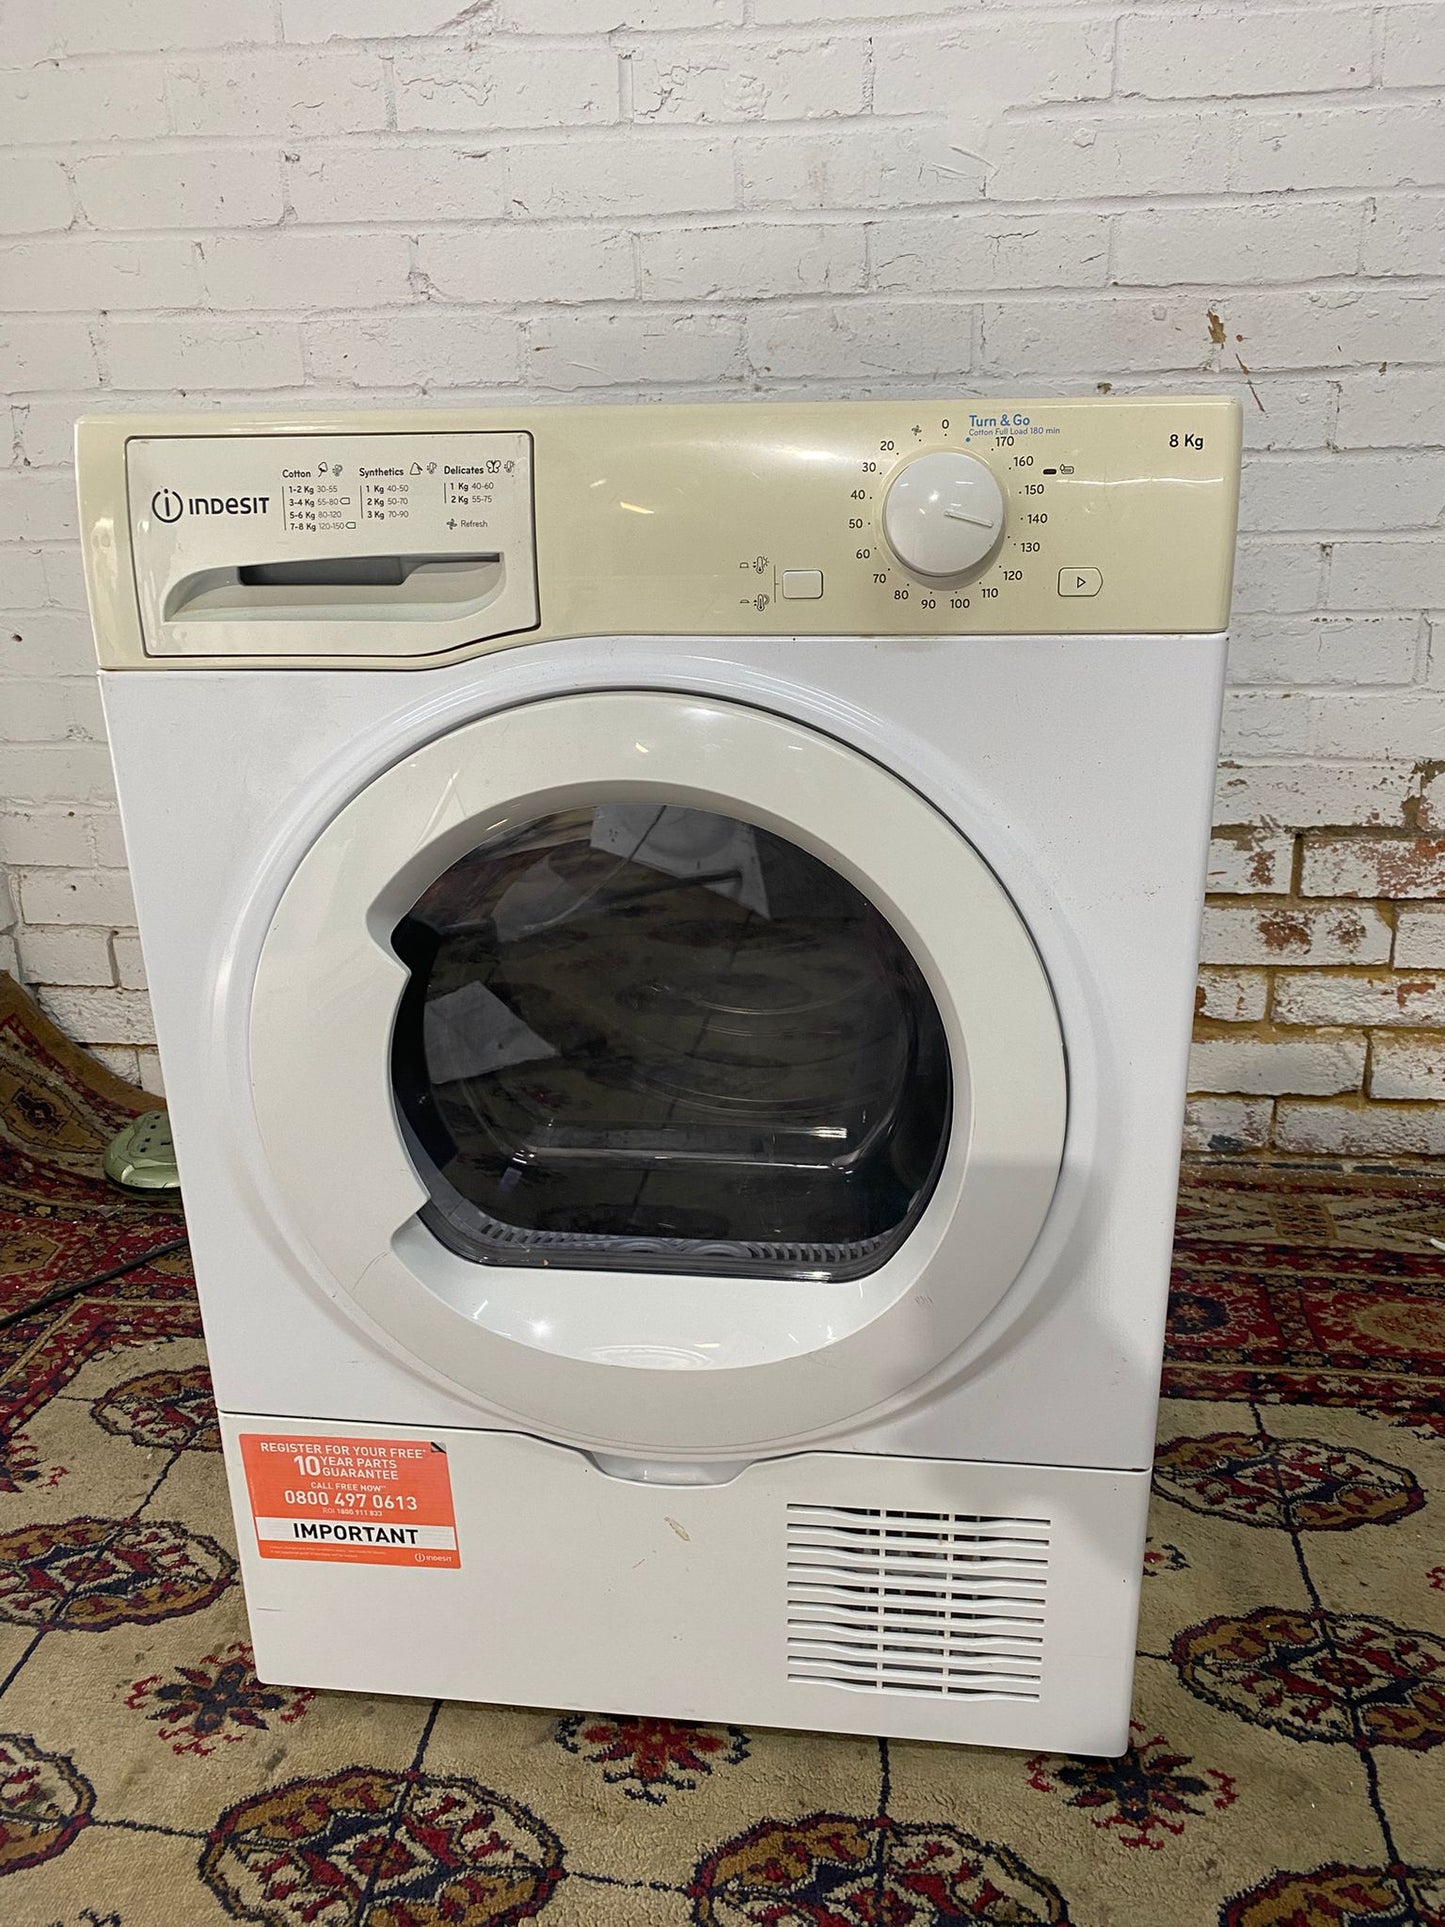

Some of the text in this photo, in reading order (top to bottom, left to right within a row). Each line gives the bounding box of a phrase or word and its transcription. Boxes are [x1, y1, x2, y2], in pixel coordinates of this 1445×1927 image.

[942, 419, 949, 429] 0
[969, 414, 1030, 428] Turn & Go
[880, 441, 894, 451] 20
[995, 437, 1015, 446] 170
[1169, 434, 1204, 450] 8 Kg
[1014, 456, 1034, 467] 160
[444, 466, 484, 475] Delicates
[862, 463, 876, 472] 30
[282, 469, 311, 478] Cotton
[359, 468, 404, 478] Synthetics
[304, 486, 314, 495] Kg
[374, 485, 384, 494] Kg
[459, 483, 468, 491] Kg
[1025, 484, 1045, 495] 150
[851, 490, 865, 500] 40
[305, 499, 314, 507] Kg
[374, 498, 384, 507] Kg
[387, 497, 408, 505] 50-70
[459, 496, 468, 505] Kg
[305, 512, 315, 520] Kg
[374, 511, 385, 520] Kg
[1028, 514, 1048, 524] 140
[306, 523, 316, 532] Kg
[461, 520, 488, 528] Refresh
[849, 519, 863, 528] 50
[1021, 542, 1040, 552] 130
[856, 549, 870, 559] 60
[873, 574, 886, 584] 70
[1004, 571, 1022, 581] 120
[894, 590, 909, 600] 80
[982, 588, 998, 598] 110
[921, 600, 936, 609] 90
[950, 599, 970, 609] 100
[260, 1443, 322, 1454] REGISTER
[325, 1445, 349, 1455] FOR
[352, 1447, 386, 1457] YOUR
[294, 1456, 397, 1476] 10 YEAR PARTS
[323, 1467, 398, 1480] GUARANTEE
[284, 1490, 417, 1510] 0800 497 0613
[293, 1523, 418, 1544] IMPORTANT
